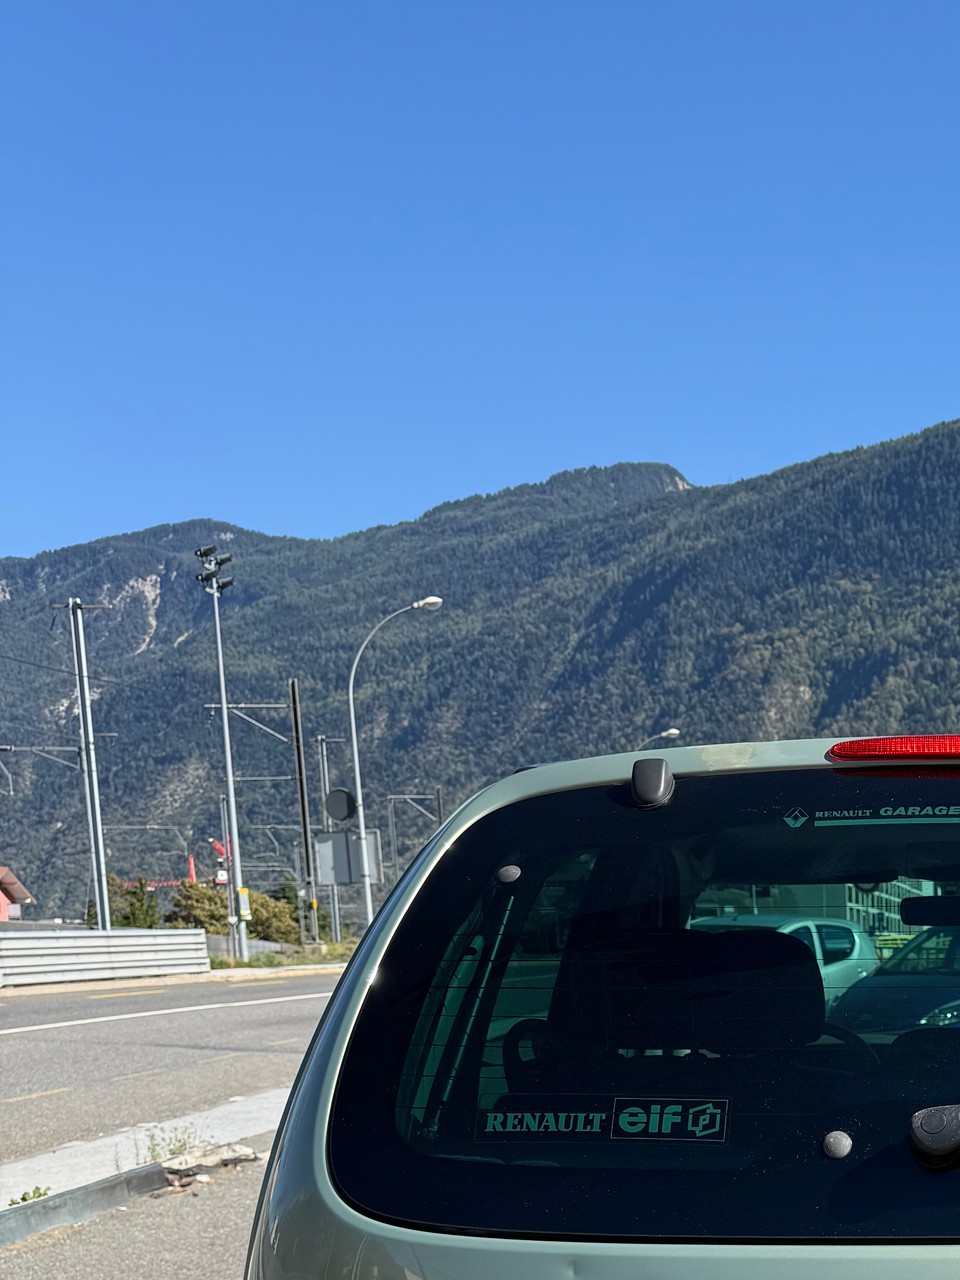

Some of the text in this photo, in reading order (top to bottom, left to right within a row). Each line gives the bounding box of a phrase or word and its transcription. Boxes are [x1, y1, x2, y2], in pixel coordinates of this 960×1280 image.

[815, 809, 873, 818] RENAULT
[879, 806, 960, 816] GARAGE
[485, 1105, 682, 1133] RENAULT elf
